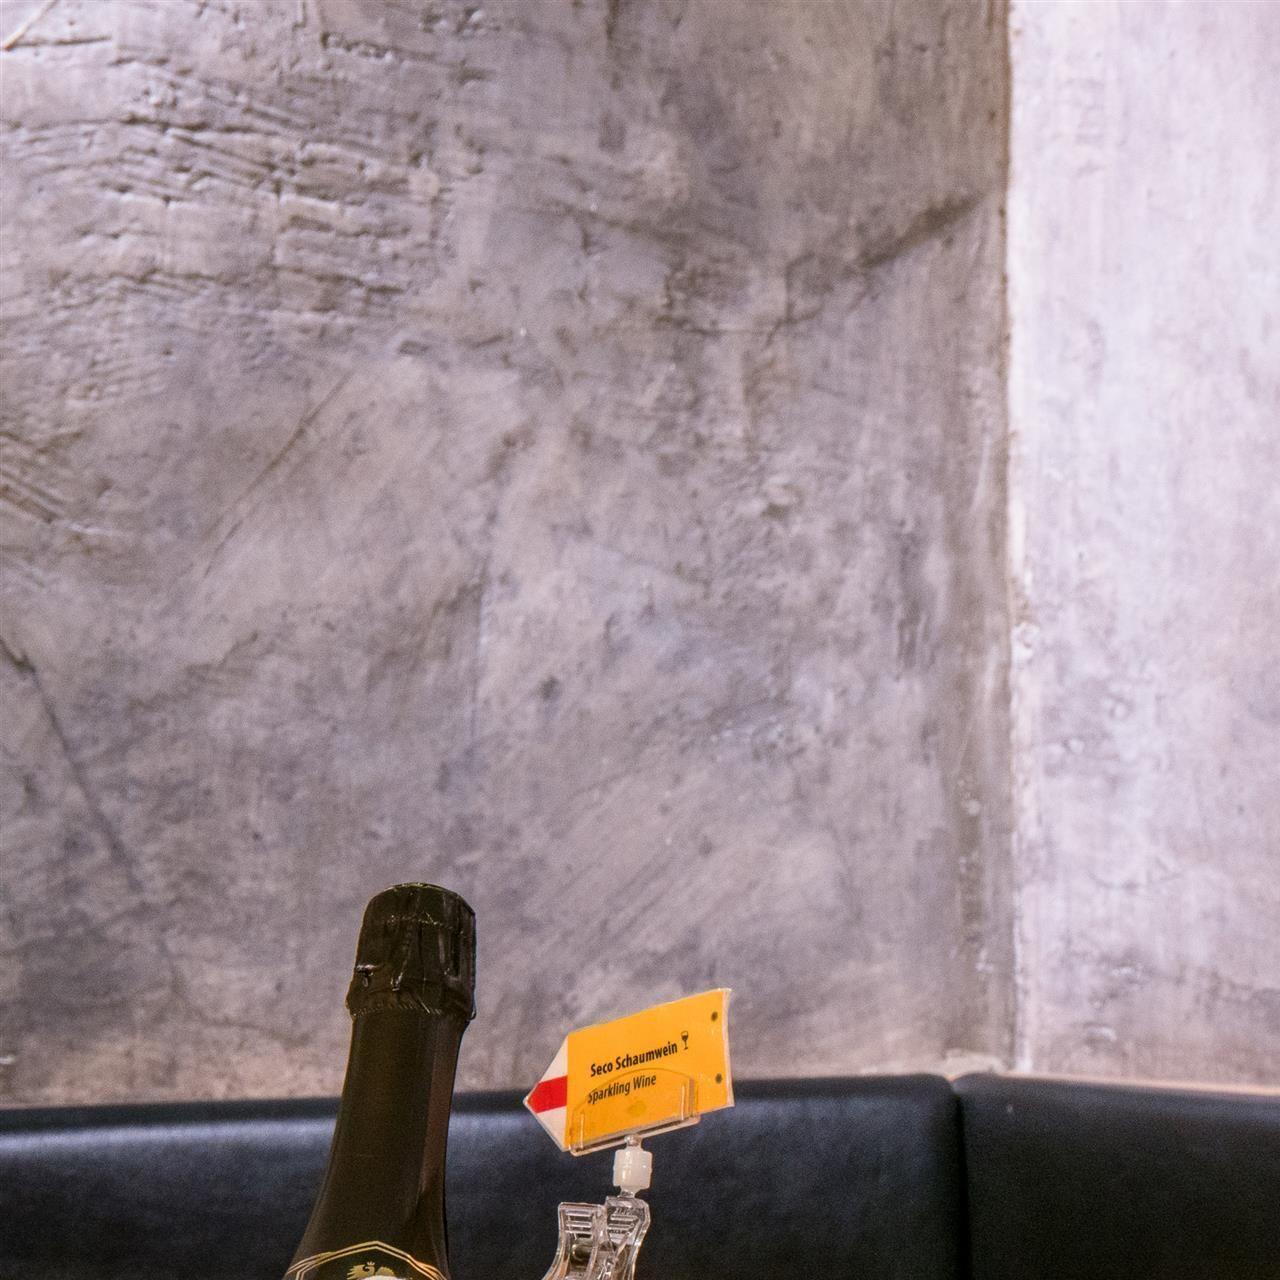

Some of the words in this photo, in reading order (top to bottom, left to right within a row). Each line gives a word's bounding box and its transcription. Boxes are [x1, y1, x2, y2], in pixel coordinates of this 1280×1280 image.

[590, 1062, 613, 1077] Seco
[615, 1041, 678, 1070] Schaumwein
[633, 1074, 656, 1090] Wine
